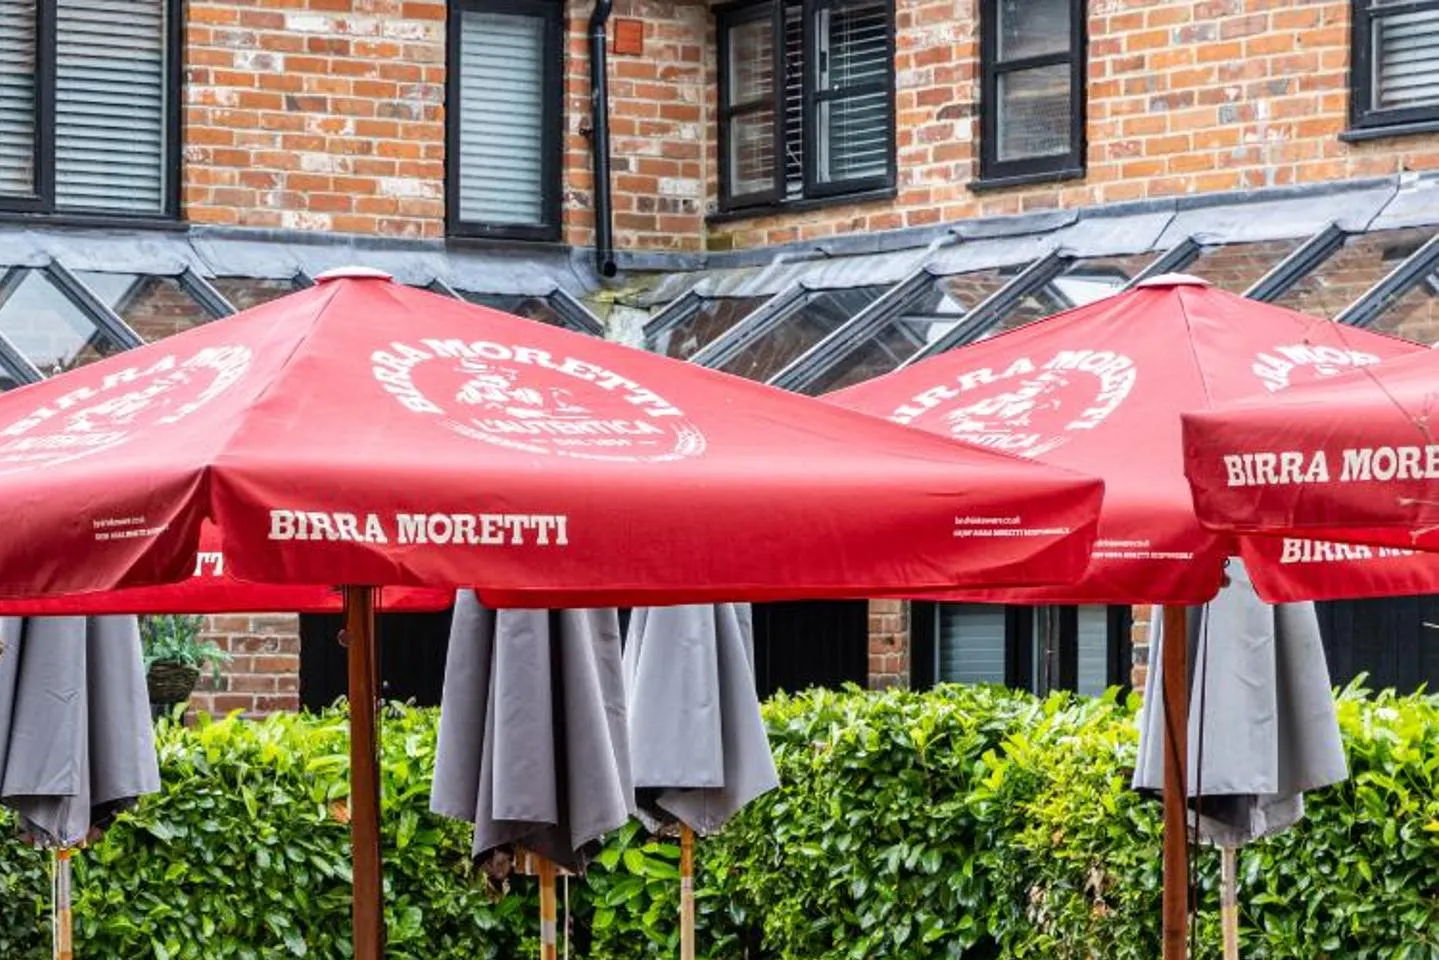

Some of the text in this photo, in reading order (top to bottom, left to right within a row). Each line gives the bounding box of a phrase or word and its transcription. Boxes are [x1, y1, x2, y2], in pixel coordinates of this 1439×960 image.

[371, 338, 684, 417] BIRRA MORETTI
[1224, 445, 1439, 487] BIRRA MORE
[267, 509, 569, 545] BIRRA MORETTI
